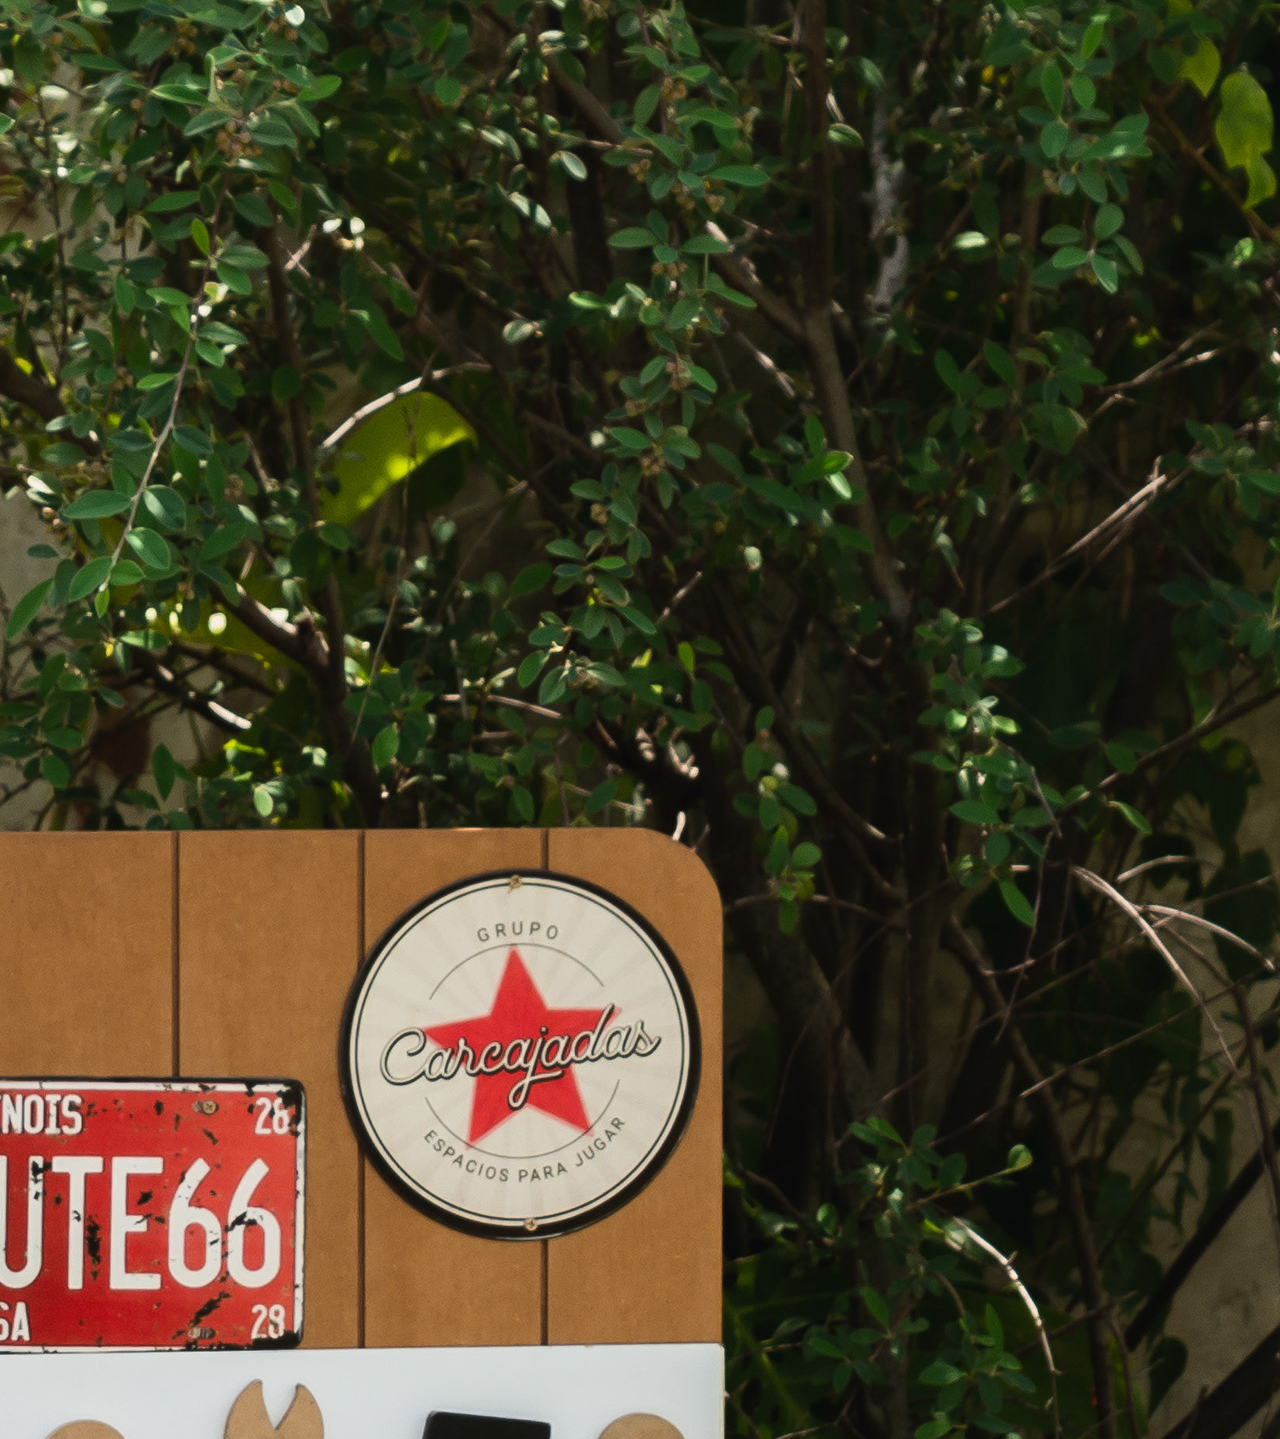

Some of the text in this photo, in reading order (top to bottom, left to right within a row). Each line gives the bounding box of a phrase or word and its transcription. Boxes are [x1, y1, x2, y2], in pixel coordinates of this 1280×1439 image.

[477, 921, 560, 942] GRUPO
[380, 1002, 662, 1111] Carcajadas
[423, 1116, 626, 1183] ESPACIOS PARA JUGAR
